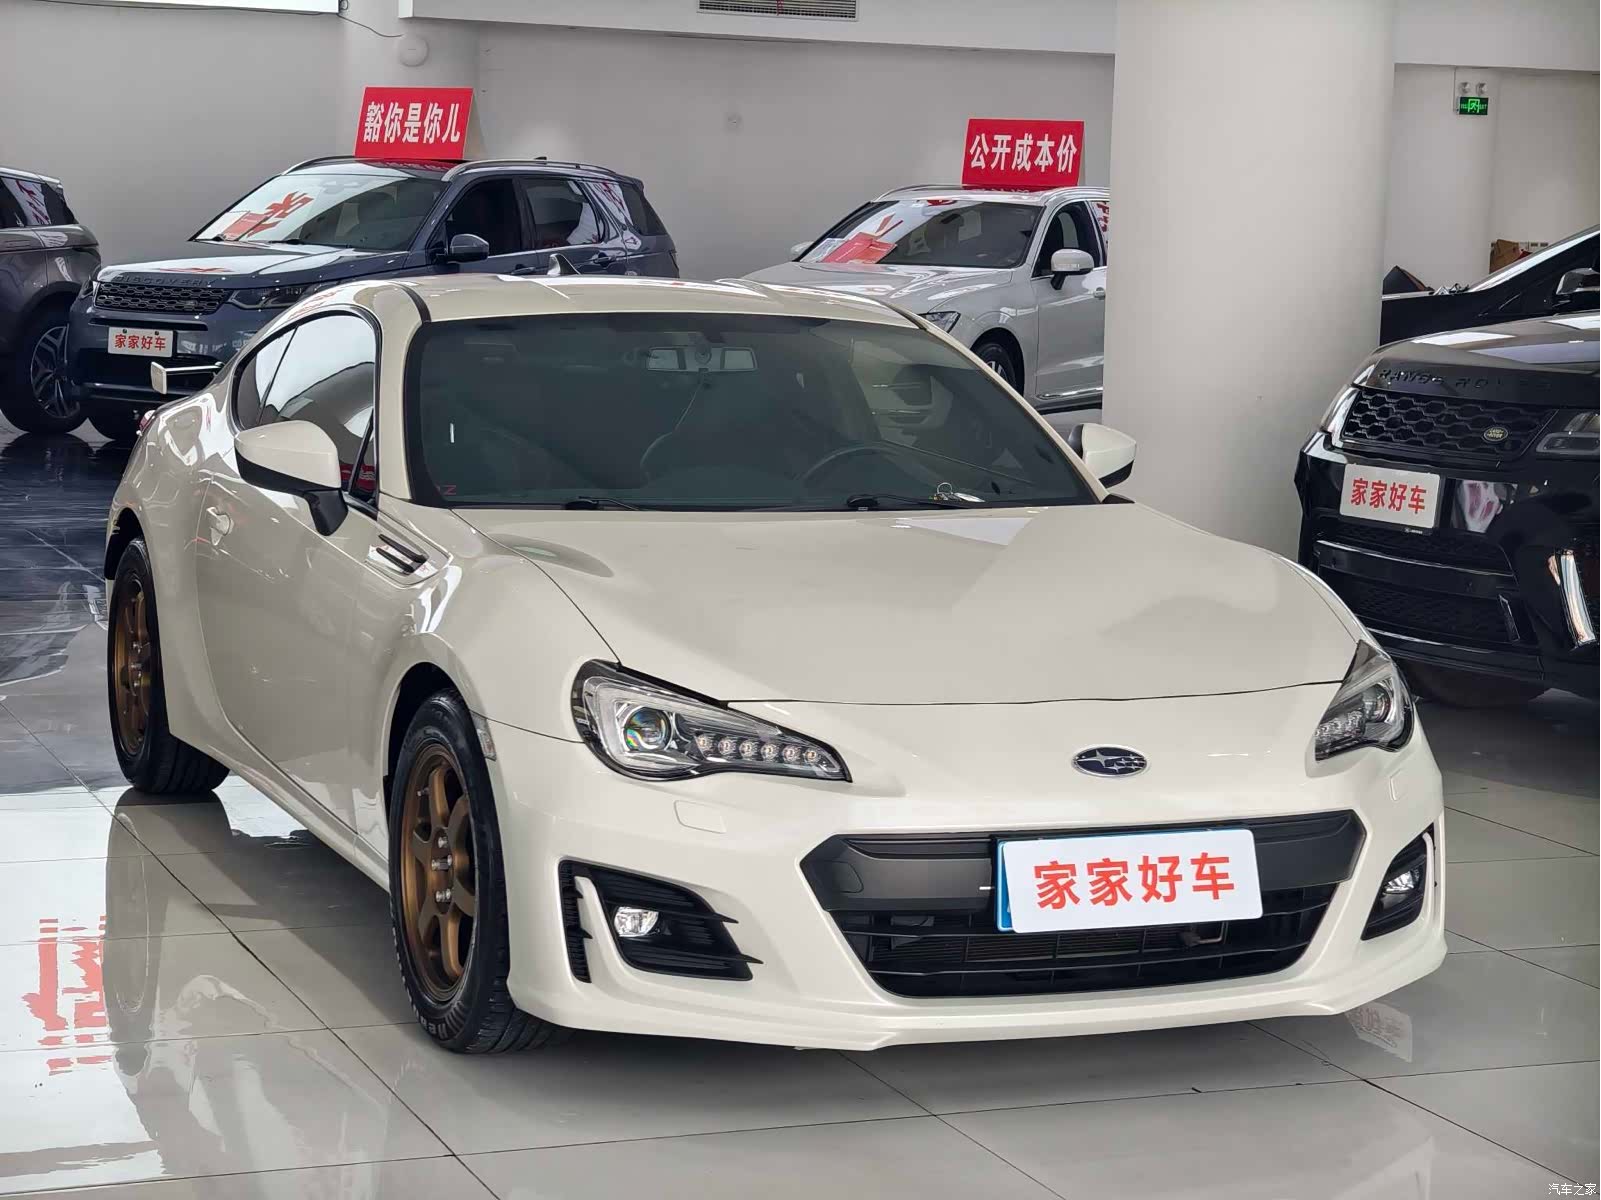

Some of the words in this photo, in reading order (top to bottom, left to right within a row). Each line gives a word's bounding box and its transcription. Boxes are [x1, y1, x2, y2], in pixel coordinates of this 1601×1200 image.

[363, 101, 460, 144] 豁你是你儿
[969, 133, 1077, 173] 公开成本价
[115, 334, 166, 351] 家家好车
[1350, 478, 1427, 514] 家家好车
[1034, 852, 1235, 909] 家家好车
